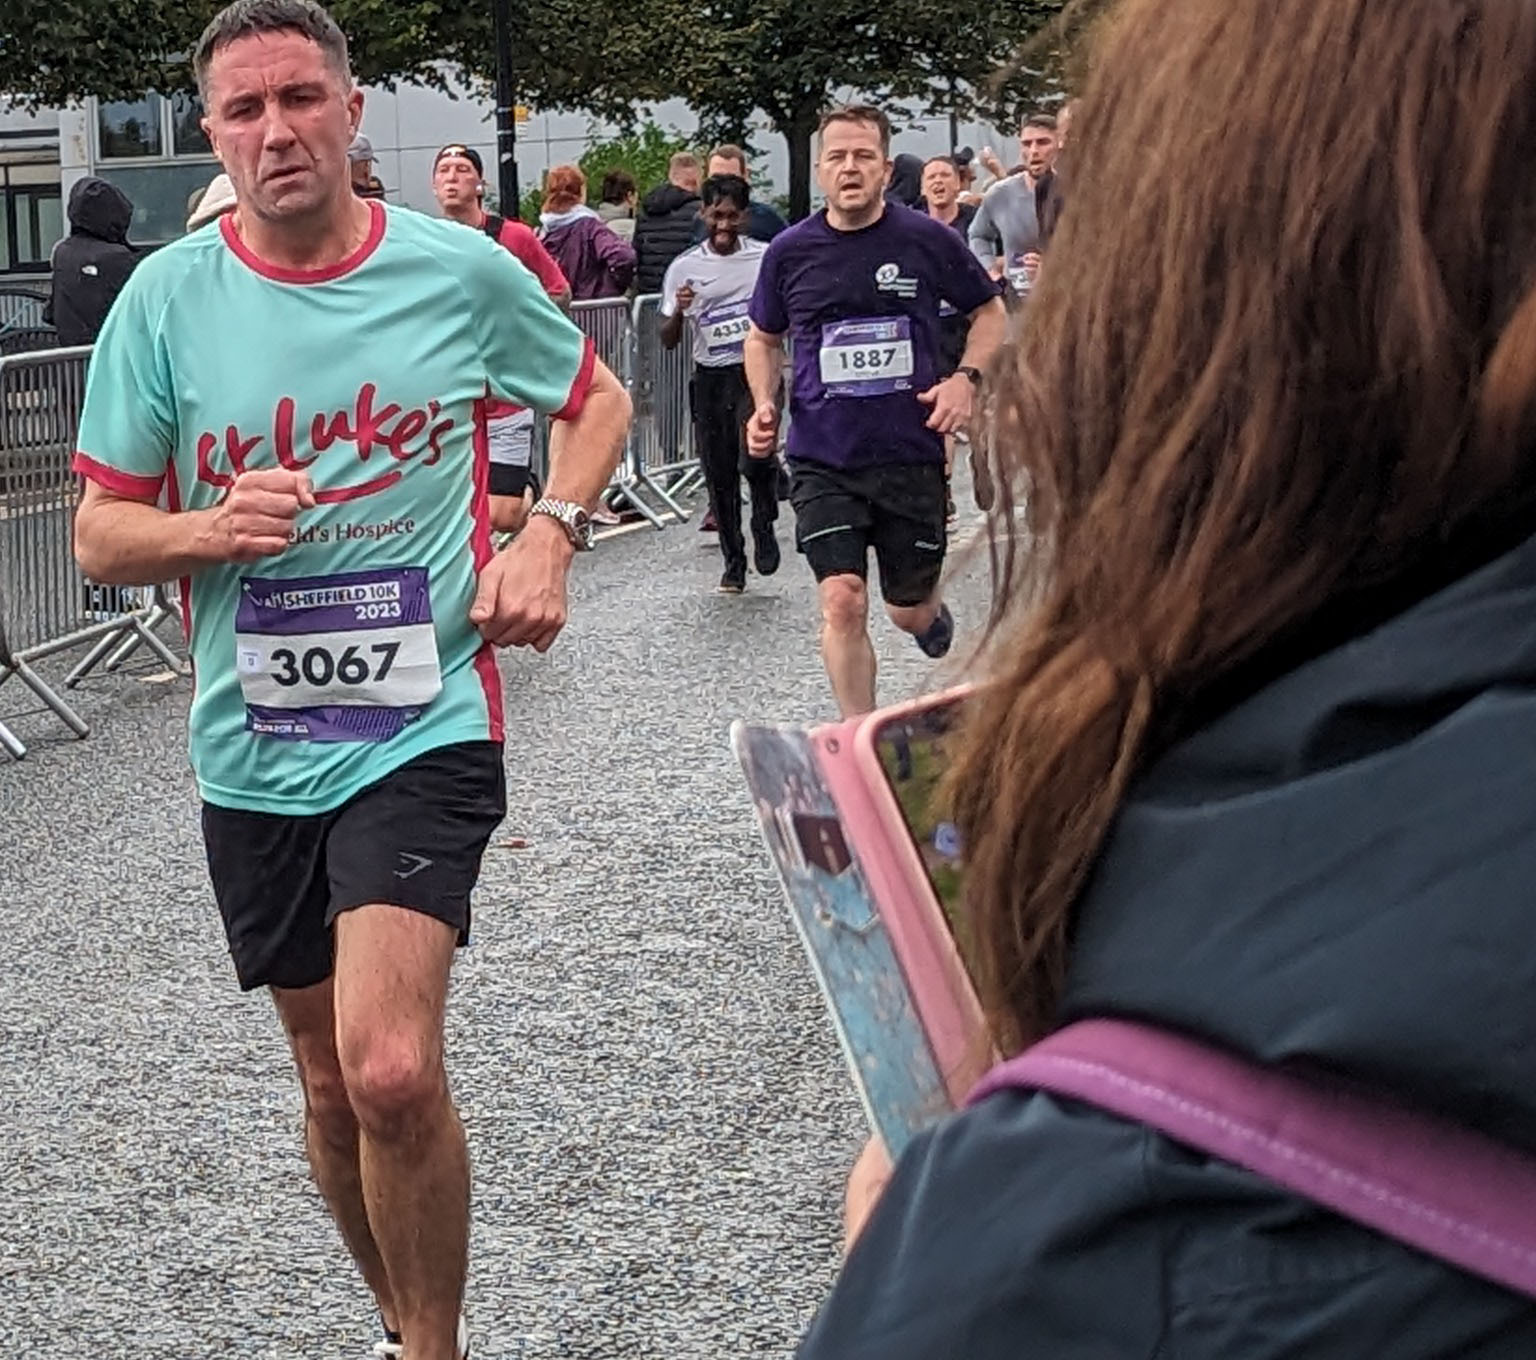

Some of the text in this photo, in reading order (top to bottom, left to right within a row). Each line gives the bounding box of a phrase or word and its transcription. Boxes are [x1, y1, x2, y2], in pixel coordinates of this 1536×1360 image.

[839, 348, 897, 370] 1887
[274, 382, 455, 472] Luke's
[335, 518, 415, 542] Hospice
[285, 588, 366, 608] SHEFFIELD
[370, 584, 397, 599] 10K
[354, 601, 402, 620] 2023
[270, 641, 402, 687] 3067
